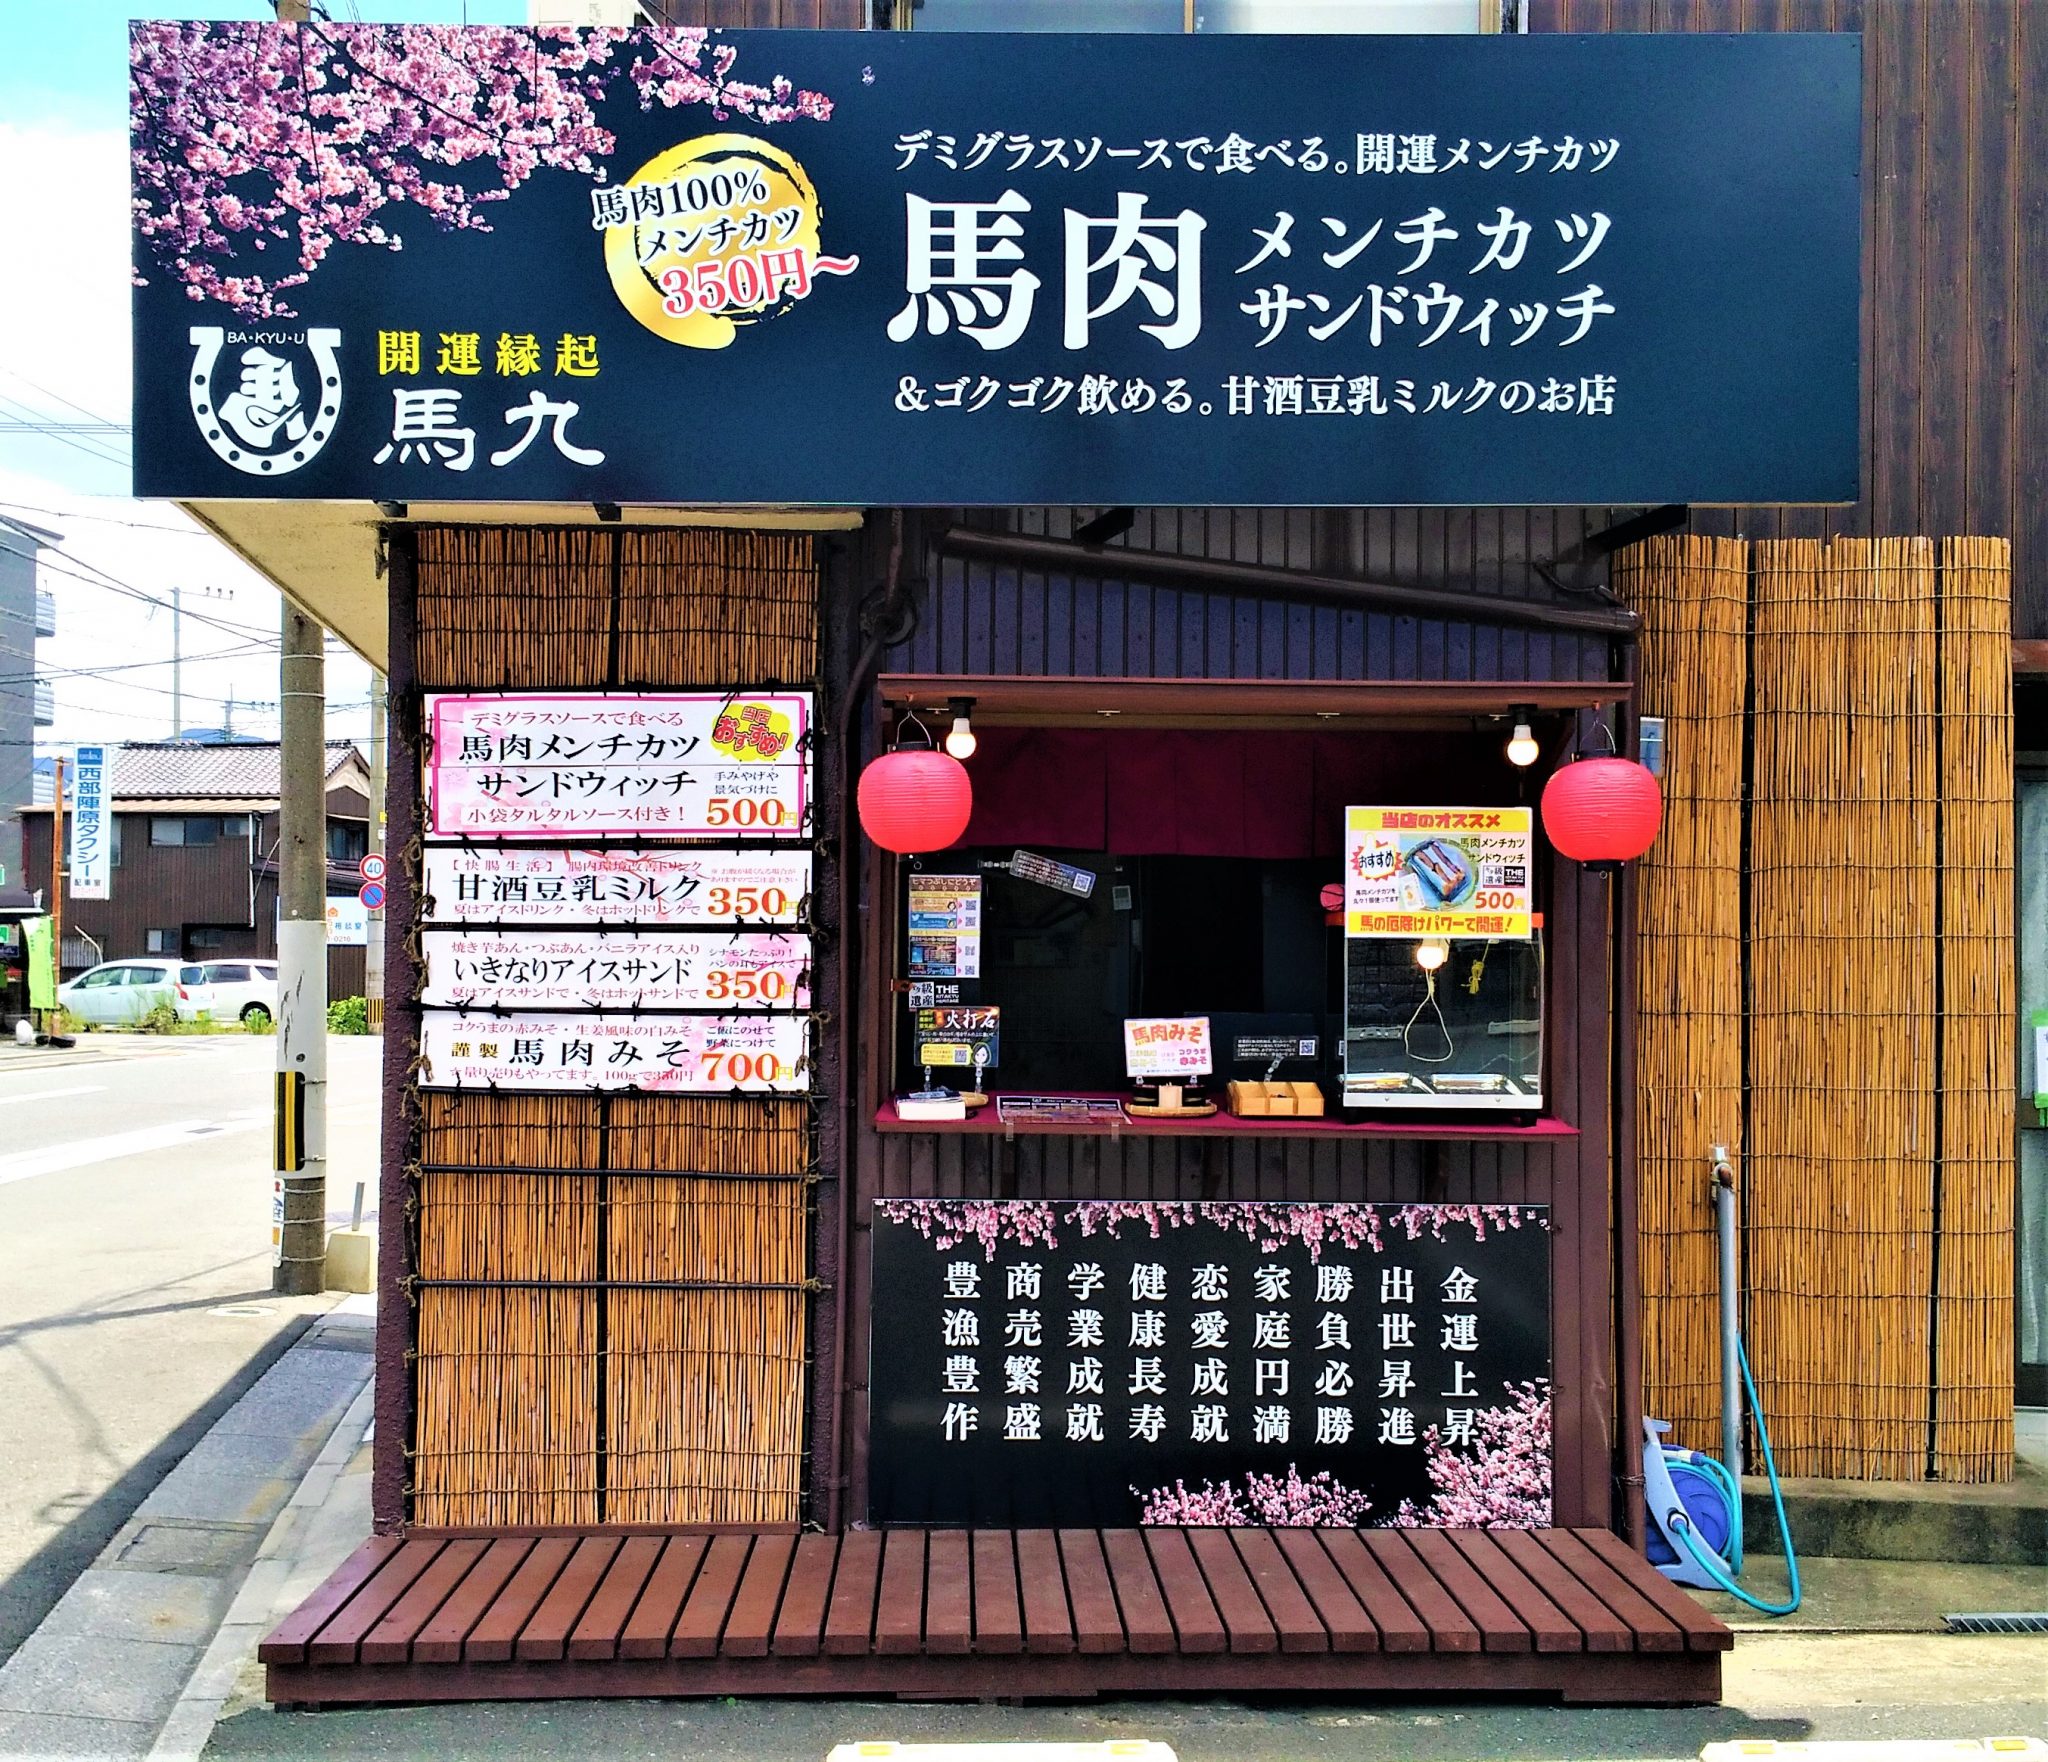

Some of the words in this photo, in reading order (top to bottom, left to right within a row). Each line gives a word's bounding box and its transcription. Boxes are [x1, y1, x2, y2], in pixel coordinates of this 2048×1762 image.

[893, 129, 1621, 176] デミグラスソースで食べる。開運メンチカツ
[593, 168, 767, 226] 馬肉100%
[642, 208, 801, 262] メンチカツ
[1235, 206, 1612, 276] メンチカツ
[886, 188, 1208, 351] 馬肉
[1239, 283, 1616, 350] サンドウィッチ
[378, 331, 601, 377] 開運縁起
[373, 388, 607, 472] 馬九
[470, 711, 684, 727] デミグラスソースで食べる
[741, 706, 772, 724] 当店
[458, 734, 700, 762] 馬肉メンチカツ
[476, 769, 698, 798] サンドウィッチ
[715, 771, 779, 781] 手みやげや
[76, 767, 102, 877] 西部陣原タクシー
[1382, 812, 1501, 829] 当店のオススメ
[1460, 838, 1526, 849] 馬肉メンチカツ
[366, 862, 381, 874] 40
[1358, 851, 1394, 869] おすすめ
[1468, 853, 1525, 863] サンドウィッチ
[452, 873, 701, 901] 甘酒豆乳ミルク
[454, 956, 692, 984] いきなりアイスサンド
[936, 985, 959, 994] THE
[945, 1009, 995, 1029] 火打石
[1132, 1024, 1202, 1044] 馬肉みそ
[451, 1042, 499, 1058] 謹製
[509, 1038, 690, 1067] 馬肉みそ
[941, 1261, 981, 1441] 豊漁豊作
[1004, 1262, 1042, 1441] 商売繁盛
[1065, 1262, 1104, 1441] 学業成就
[1128, 1263, 1167, 1442] 健康長寿
[1190, 1263, 1230, 1442] 恋愛成就
[1253, 1263, 1292, 1443] 家庭円満
[1315, 1264, 1354, 1443] 勝負必勝
[1377, 1265, 1417, 1445] 出世昇進
[1439, 1266, 1480, 1446] 金運上昇
